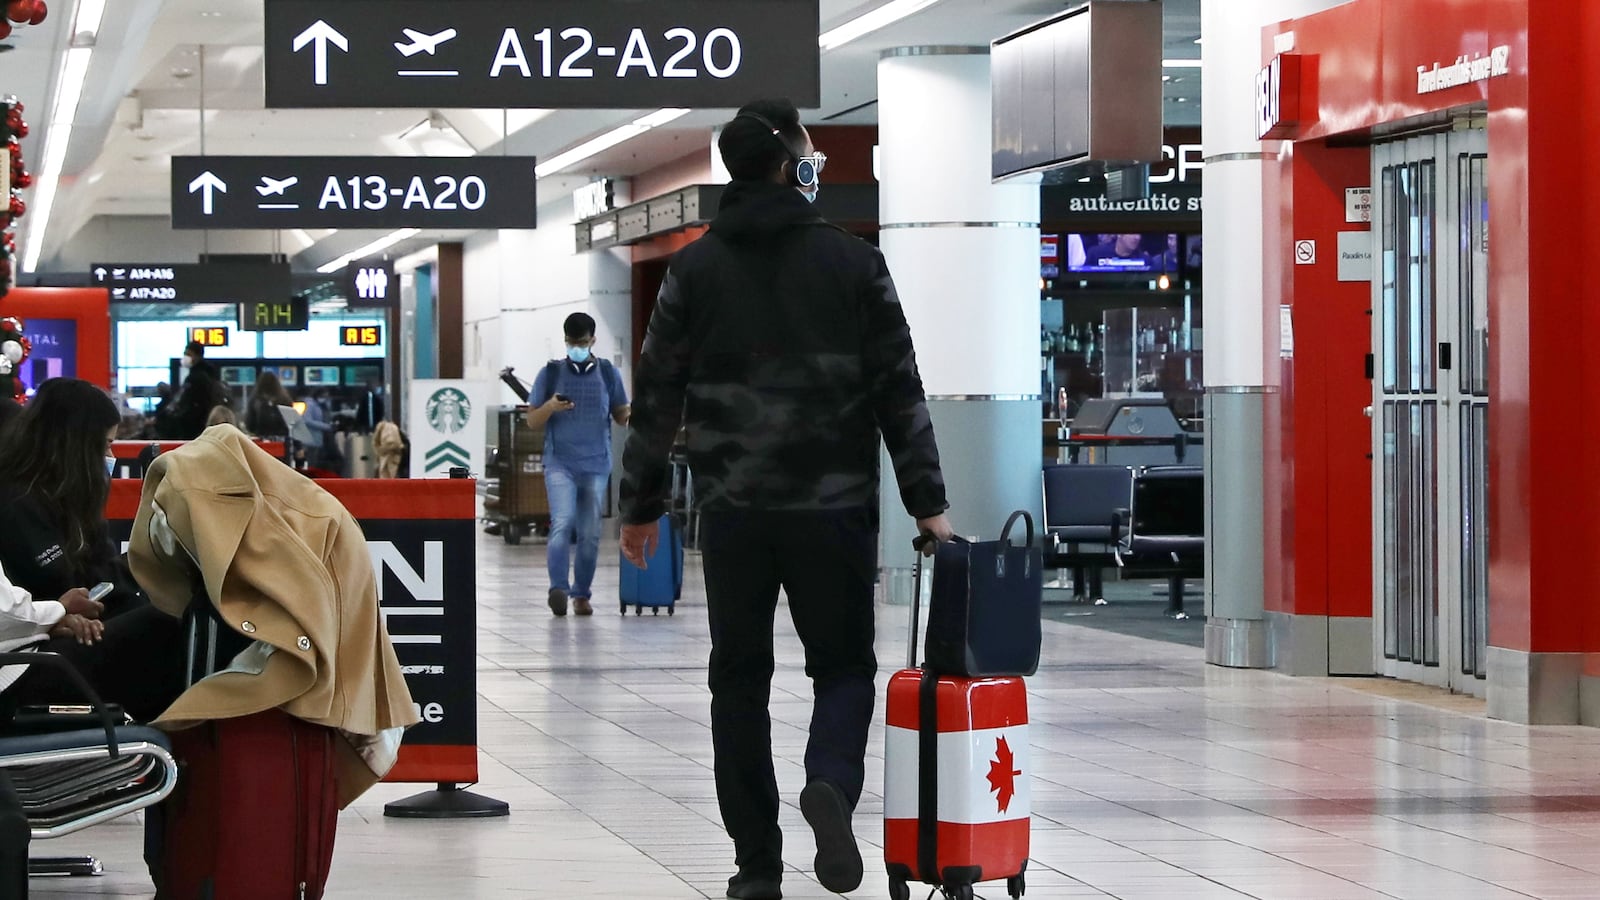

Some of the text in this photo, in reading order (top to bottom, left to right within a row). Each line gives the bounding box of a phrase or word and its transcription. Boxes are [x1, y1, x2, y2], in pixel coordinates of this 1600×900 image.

[490, 28, 741, 79] A12-A20
[1255, 54, 1280, 140] RELAY
[319, 176, 485, 210] A13-A20
[129, 268, 175, 280] A14-A16
[129, 287, 176, 299] A17-A20
[255, 303, 291, 325] A14
[346, 328, 376, 344] A15
